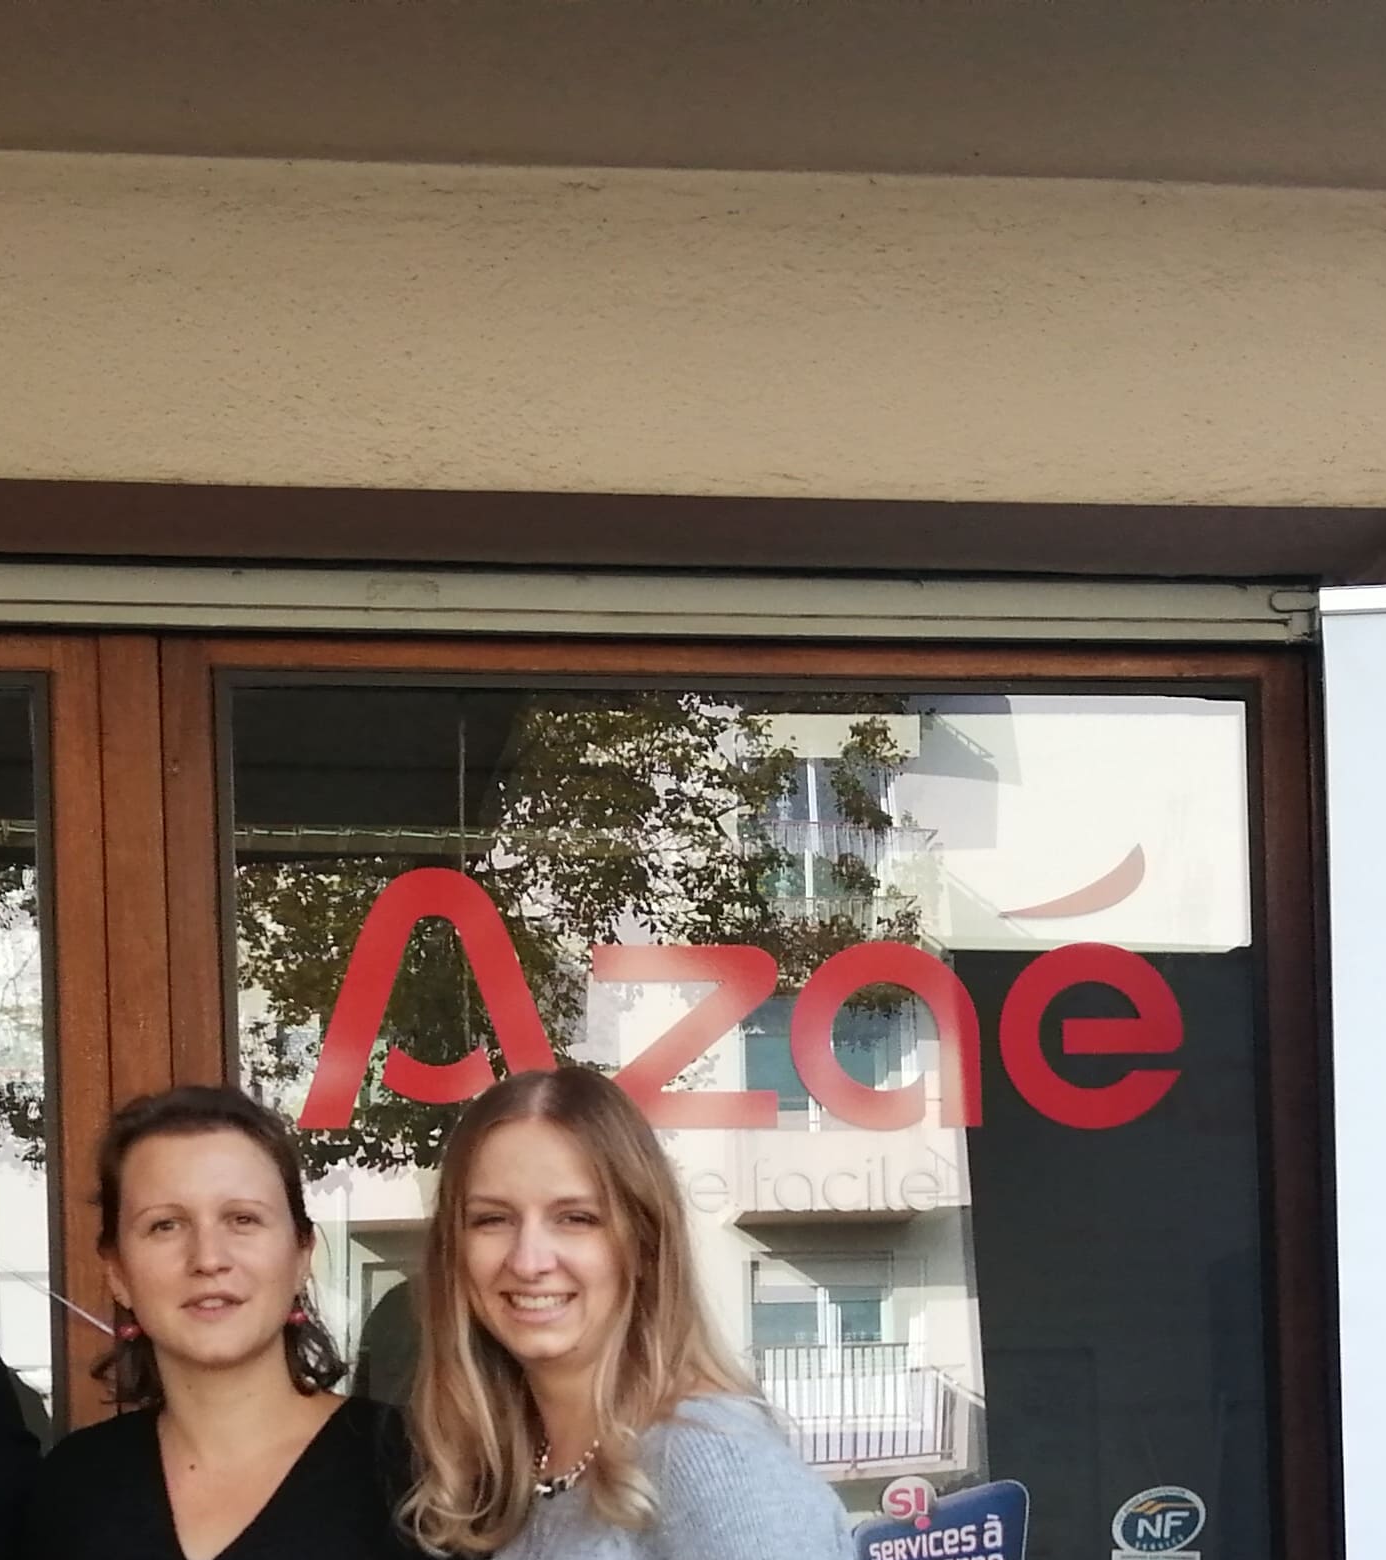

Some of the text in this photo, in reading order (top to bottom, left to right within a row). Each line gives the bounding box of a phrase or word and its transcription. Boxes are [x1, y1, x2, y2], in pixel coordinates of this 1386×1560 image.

[297, 842, 1185, 1129] Azaé
[983, 1513, 1003, 1549] à
[1136, 1510, 1190, 1539] NF
